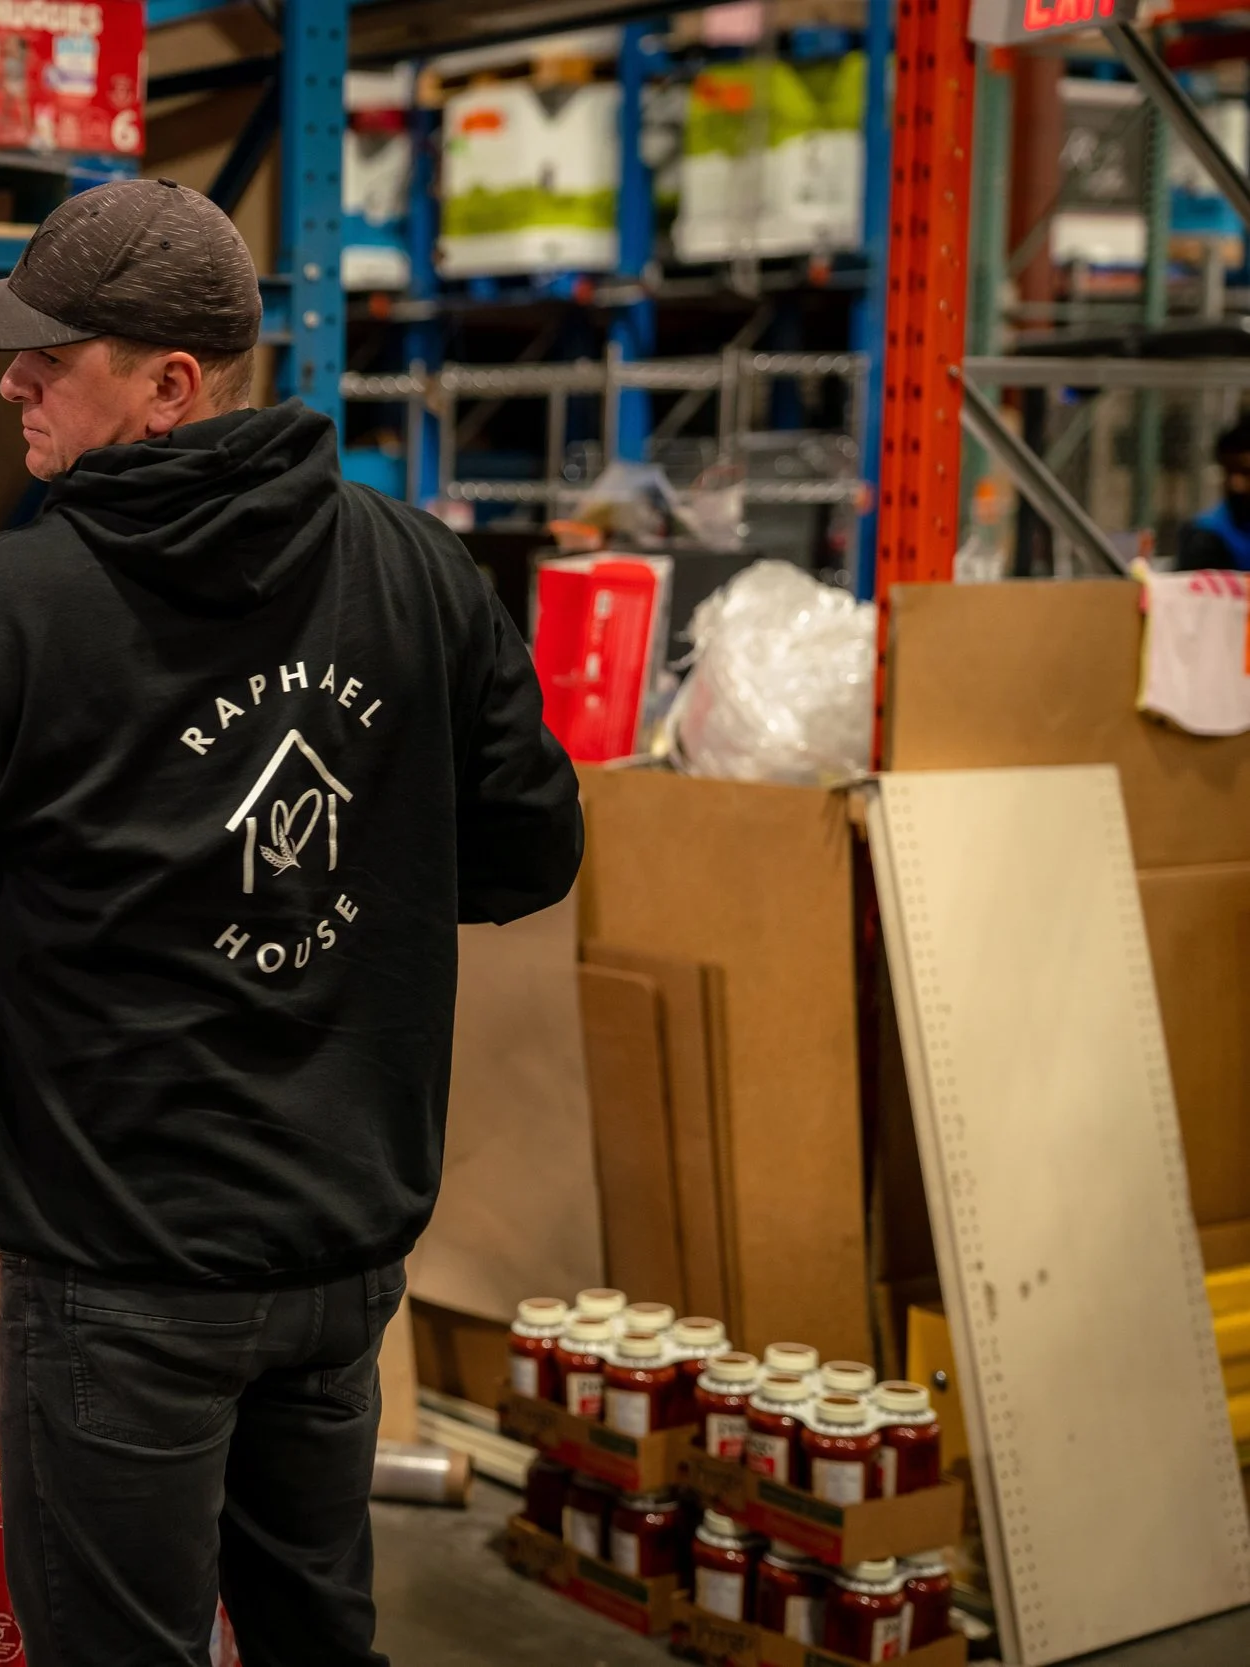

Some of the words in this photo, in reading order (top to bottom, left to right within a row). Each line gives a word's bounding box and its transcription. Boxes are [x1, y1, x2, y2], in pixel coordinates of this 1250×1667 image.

[110, 109, 140, 152] 6
[180, 661, 382, 755] RAPHAEL
[213, 894, 359, 973] HOUSE
